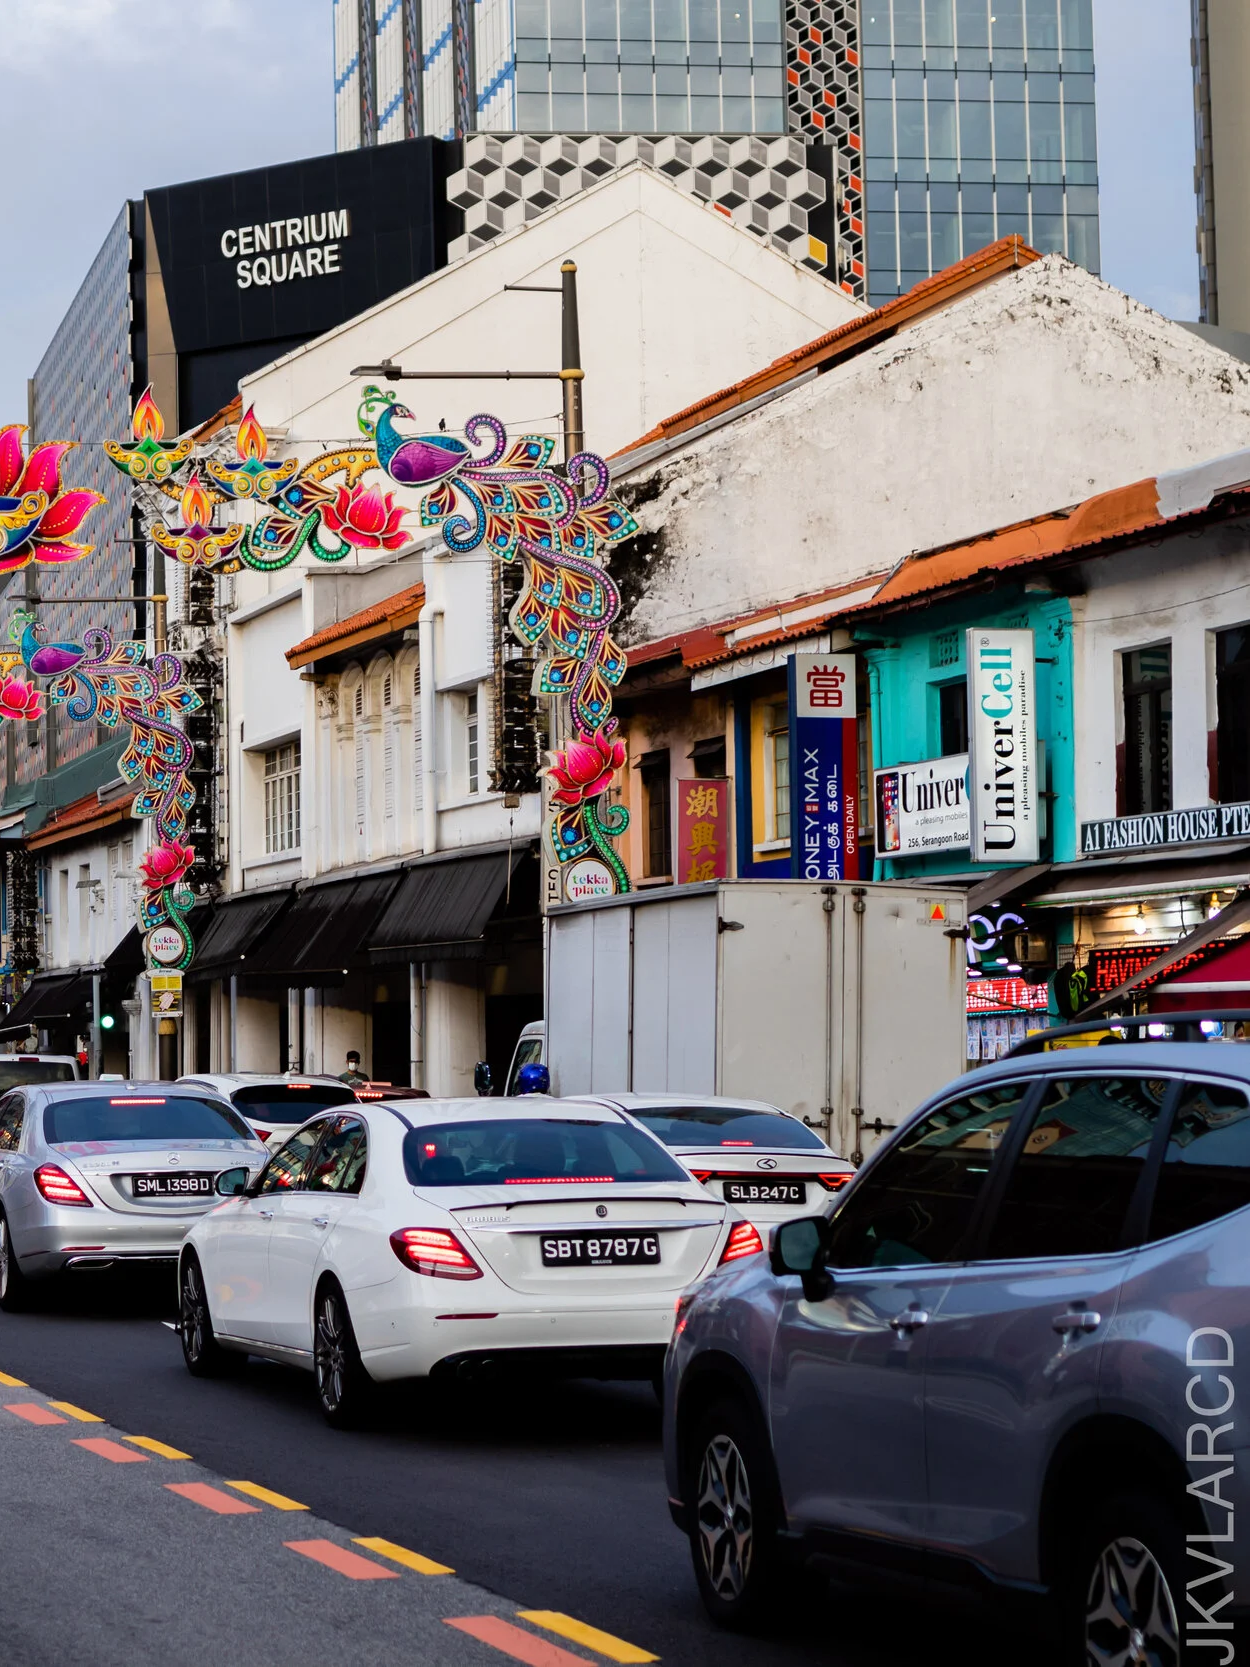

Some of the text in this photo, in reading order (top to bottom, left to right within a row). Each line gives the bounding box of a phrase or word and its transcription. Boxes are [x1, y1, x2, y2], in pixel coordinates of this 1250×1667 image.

[221, 209, 350, 258] CENTRIUM
[237, 244, 342, 289] SQUARE
[1018, 669, 1029, 717] paradise
[1019, 719, 1027, 763] mobiles
[901, 764, 969, 813] Univer
[1020, 763, 1030, 810] pleasing
[845, 794, 855, 854] OPEN DAILY
[908, 831, 969, 849] 256, Serangoon Road
[1084, 823, 1101, 851] A1
[1103, 815, 1164, 850] FASHION
[1167, 808, 1218, 843] HOUSE
[804, 815, 821, 881] ONEY
[572, 874, 608, 884] tekka
[572, 886, 608, 897] place
[153, 936, 179, 944] tekka
